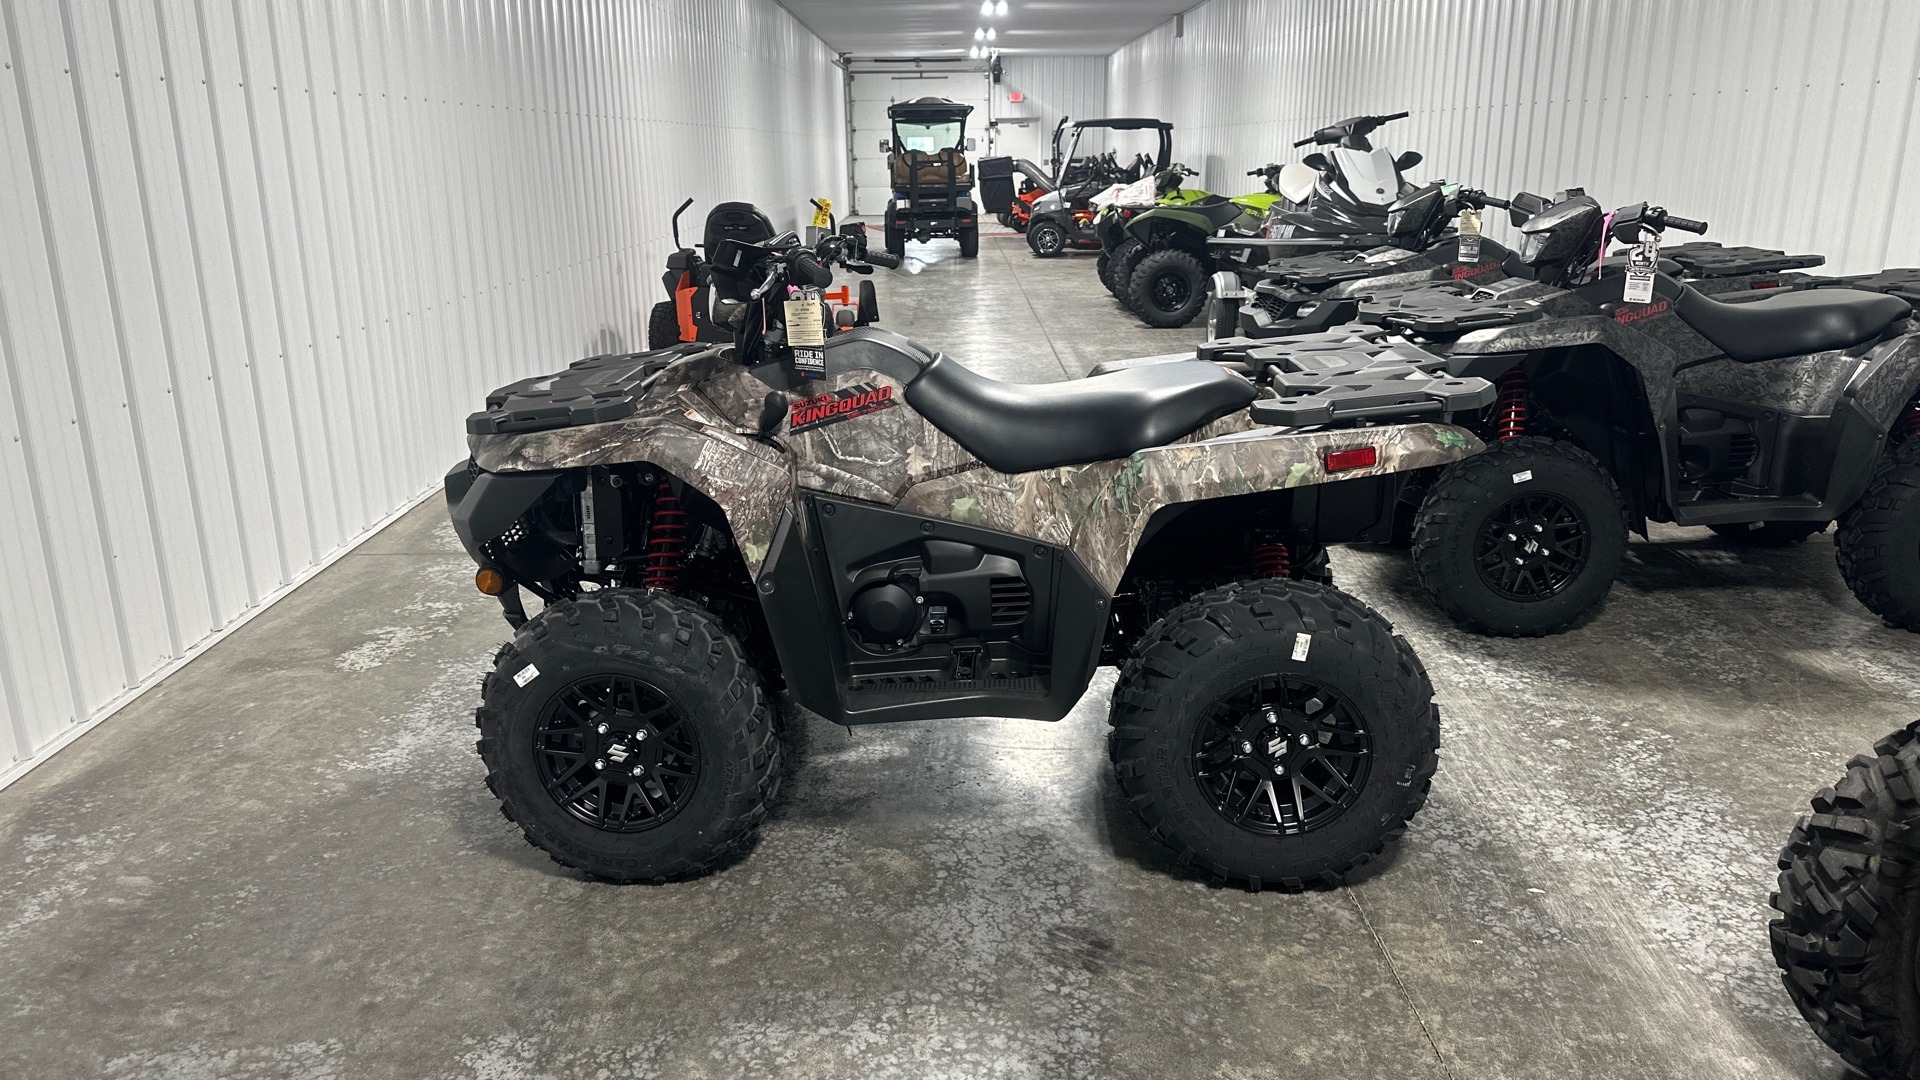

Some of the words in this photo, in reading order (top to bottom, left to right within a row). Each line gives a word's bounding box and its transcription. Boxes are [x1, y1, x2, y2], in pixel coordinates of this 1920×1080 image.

[821, 202, 830, 224] SOLD
[1451, 262, 1496, 280] INGQUAD
[1614, 301, 1667, 324] NGQUAD
[794, 350, 813, 359] RIDE
[815, 351, 824, 359] IN
[794, 357, 824, 366] CONFIDENCE
[791, 386, 892, 427] KINGQUAD
[793, 395, 828, 410] SUZUKI
